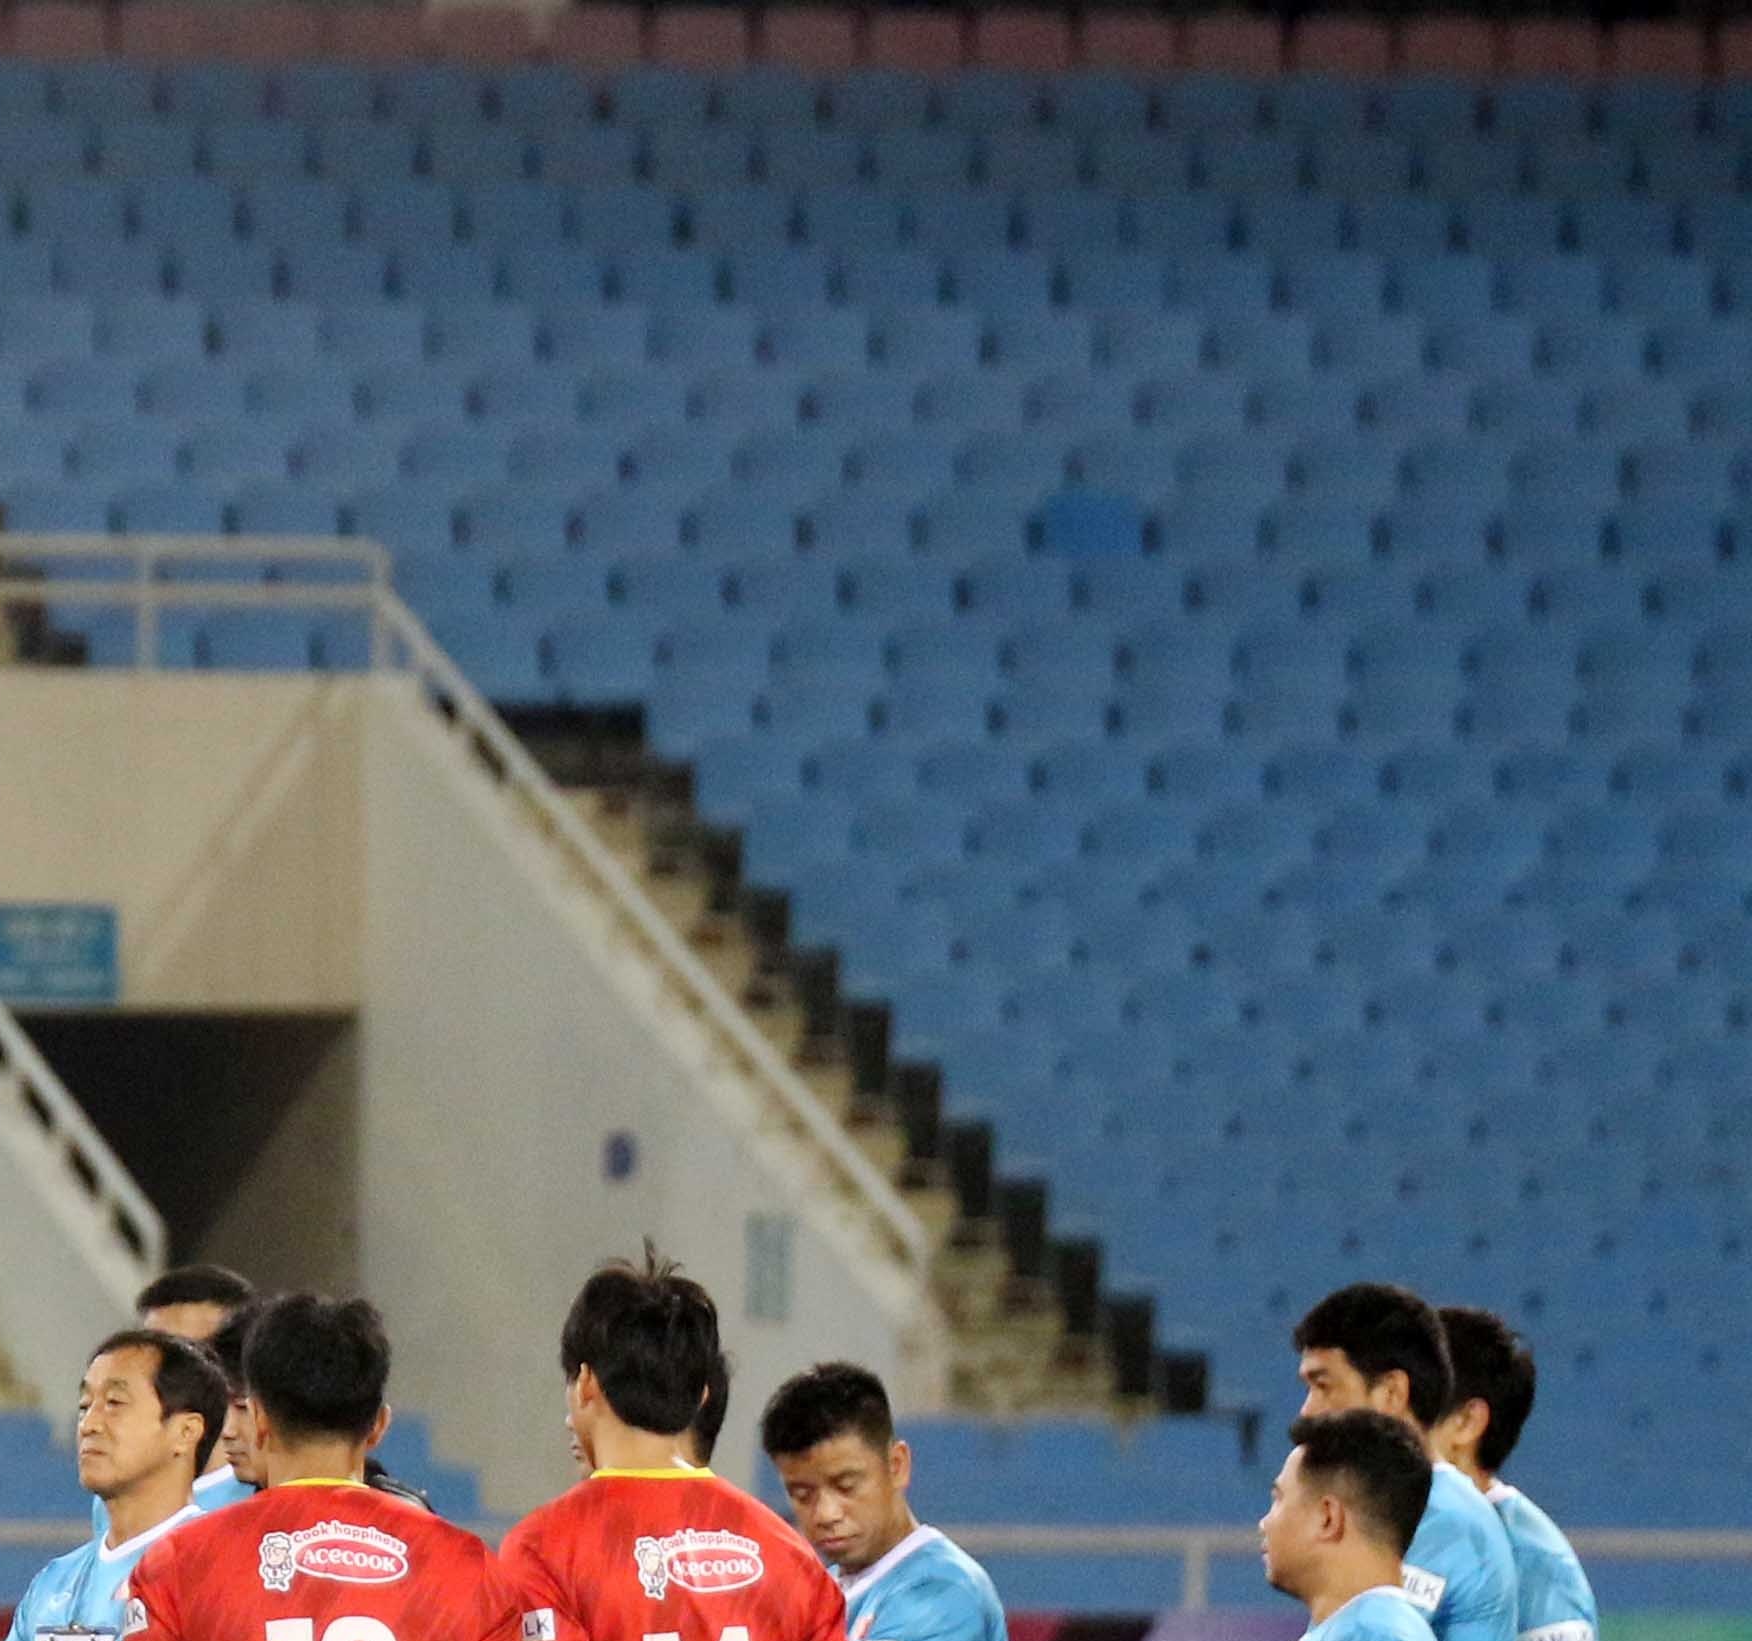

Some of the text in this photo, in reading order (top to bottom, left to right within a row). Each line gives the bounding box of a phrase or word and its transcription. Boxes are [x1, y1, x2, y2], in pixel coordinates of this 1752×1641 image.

[294, 1522, 404, 1552] Cook happiness
[689, 1530, 757, 1552] happiness
